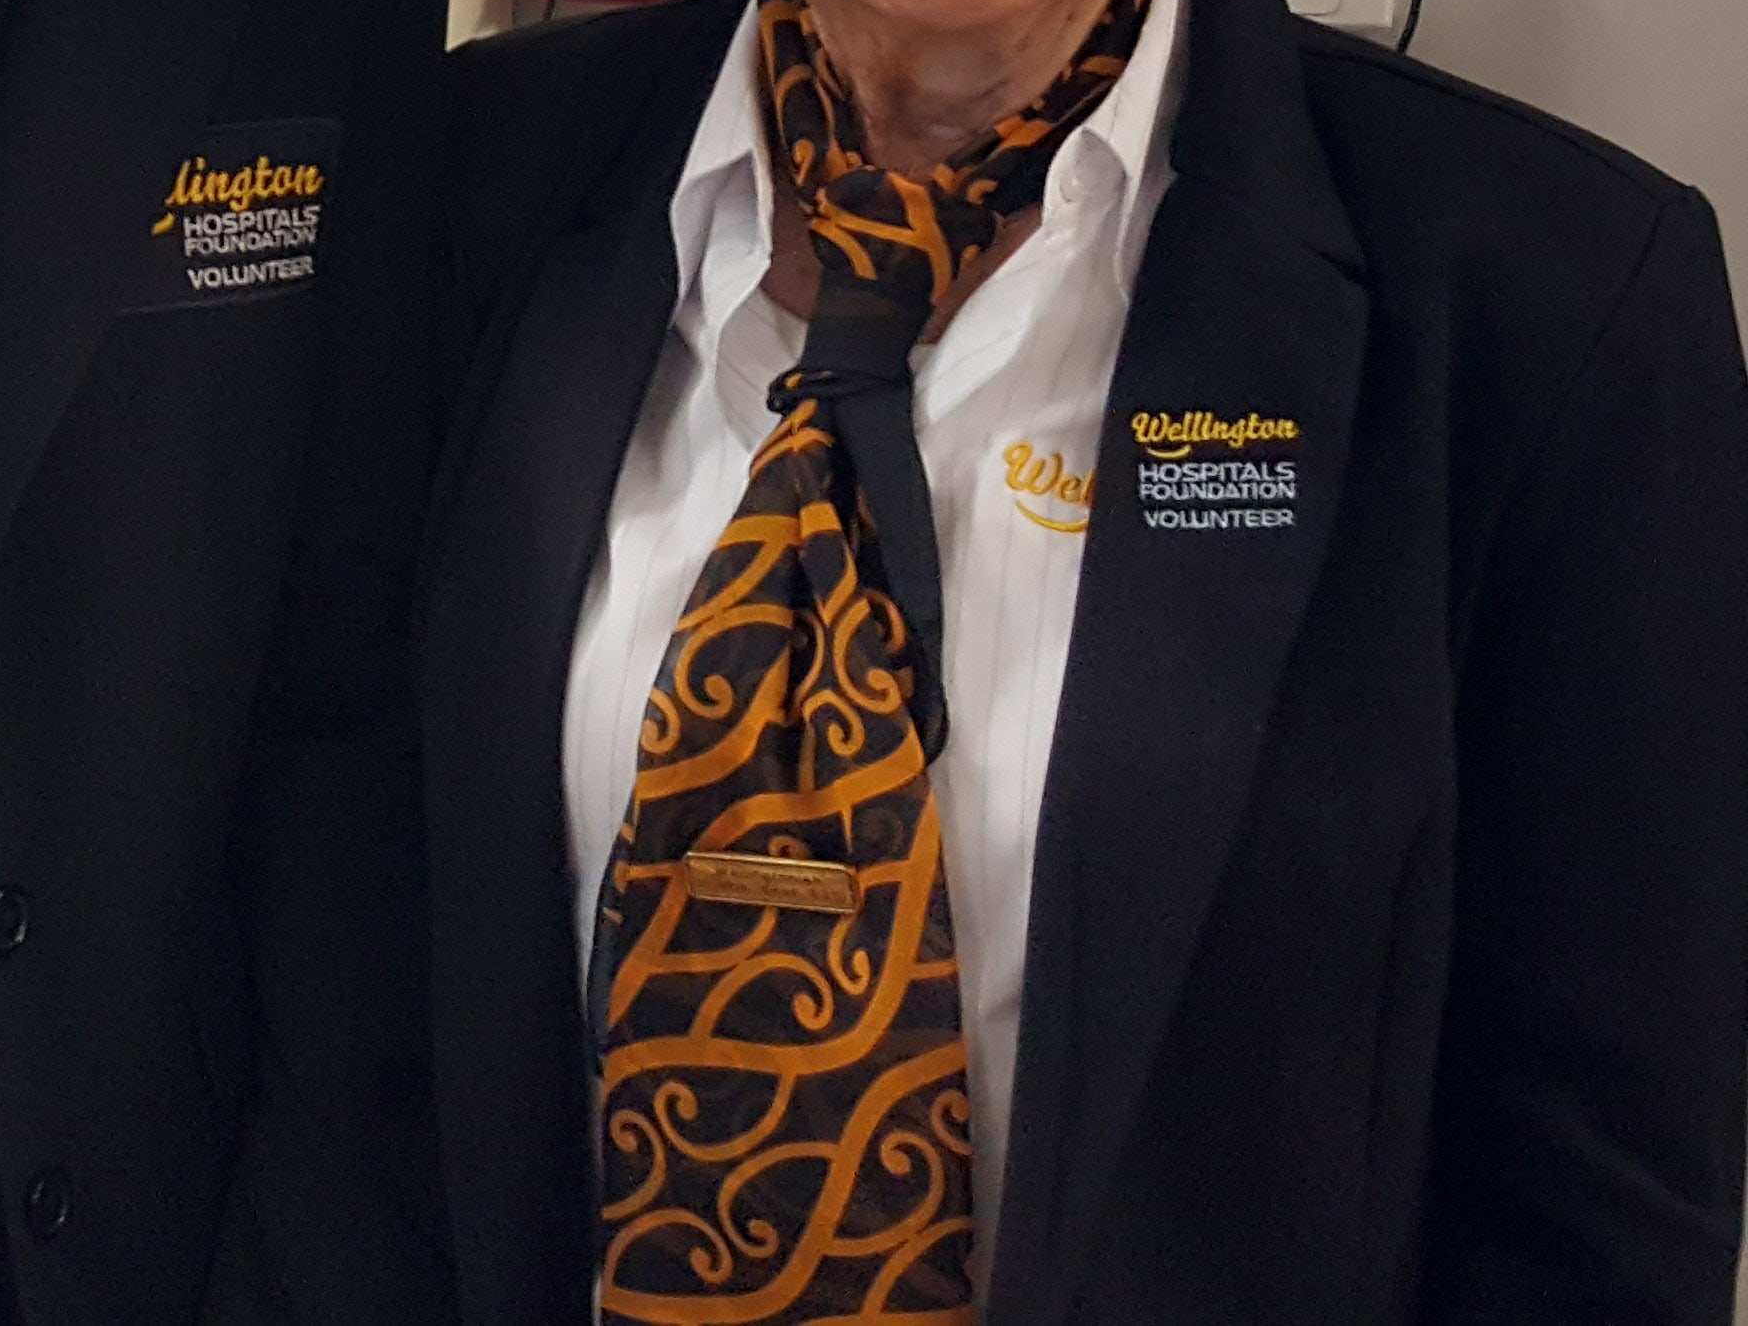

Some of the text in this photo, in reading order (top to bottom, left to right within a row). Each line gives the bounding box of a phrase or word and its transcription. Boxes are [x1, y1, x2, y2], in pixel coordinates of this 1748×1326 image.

[165, 156, 325, 211] lington
[183, 205, 321, 238] HOSPITALS
[183, 227, 318, 258] FOUNDATION
[187, 255, 316, 291] VOLUNTEER
[1131, 411, 1300, 449] Wellington
[1138, 461, 1296, 483] HOSPITALS
[1139, 481, 1296, 501] FOUNDATION
[1143, 508, 1295, 530] VOLUNTEER
